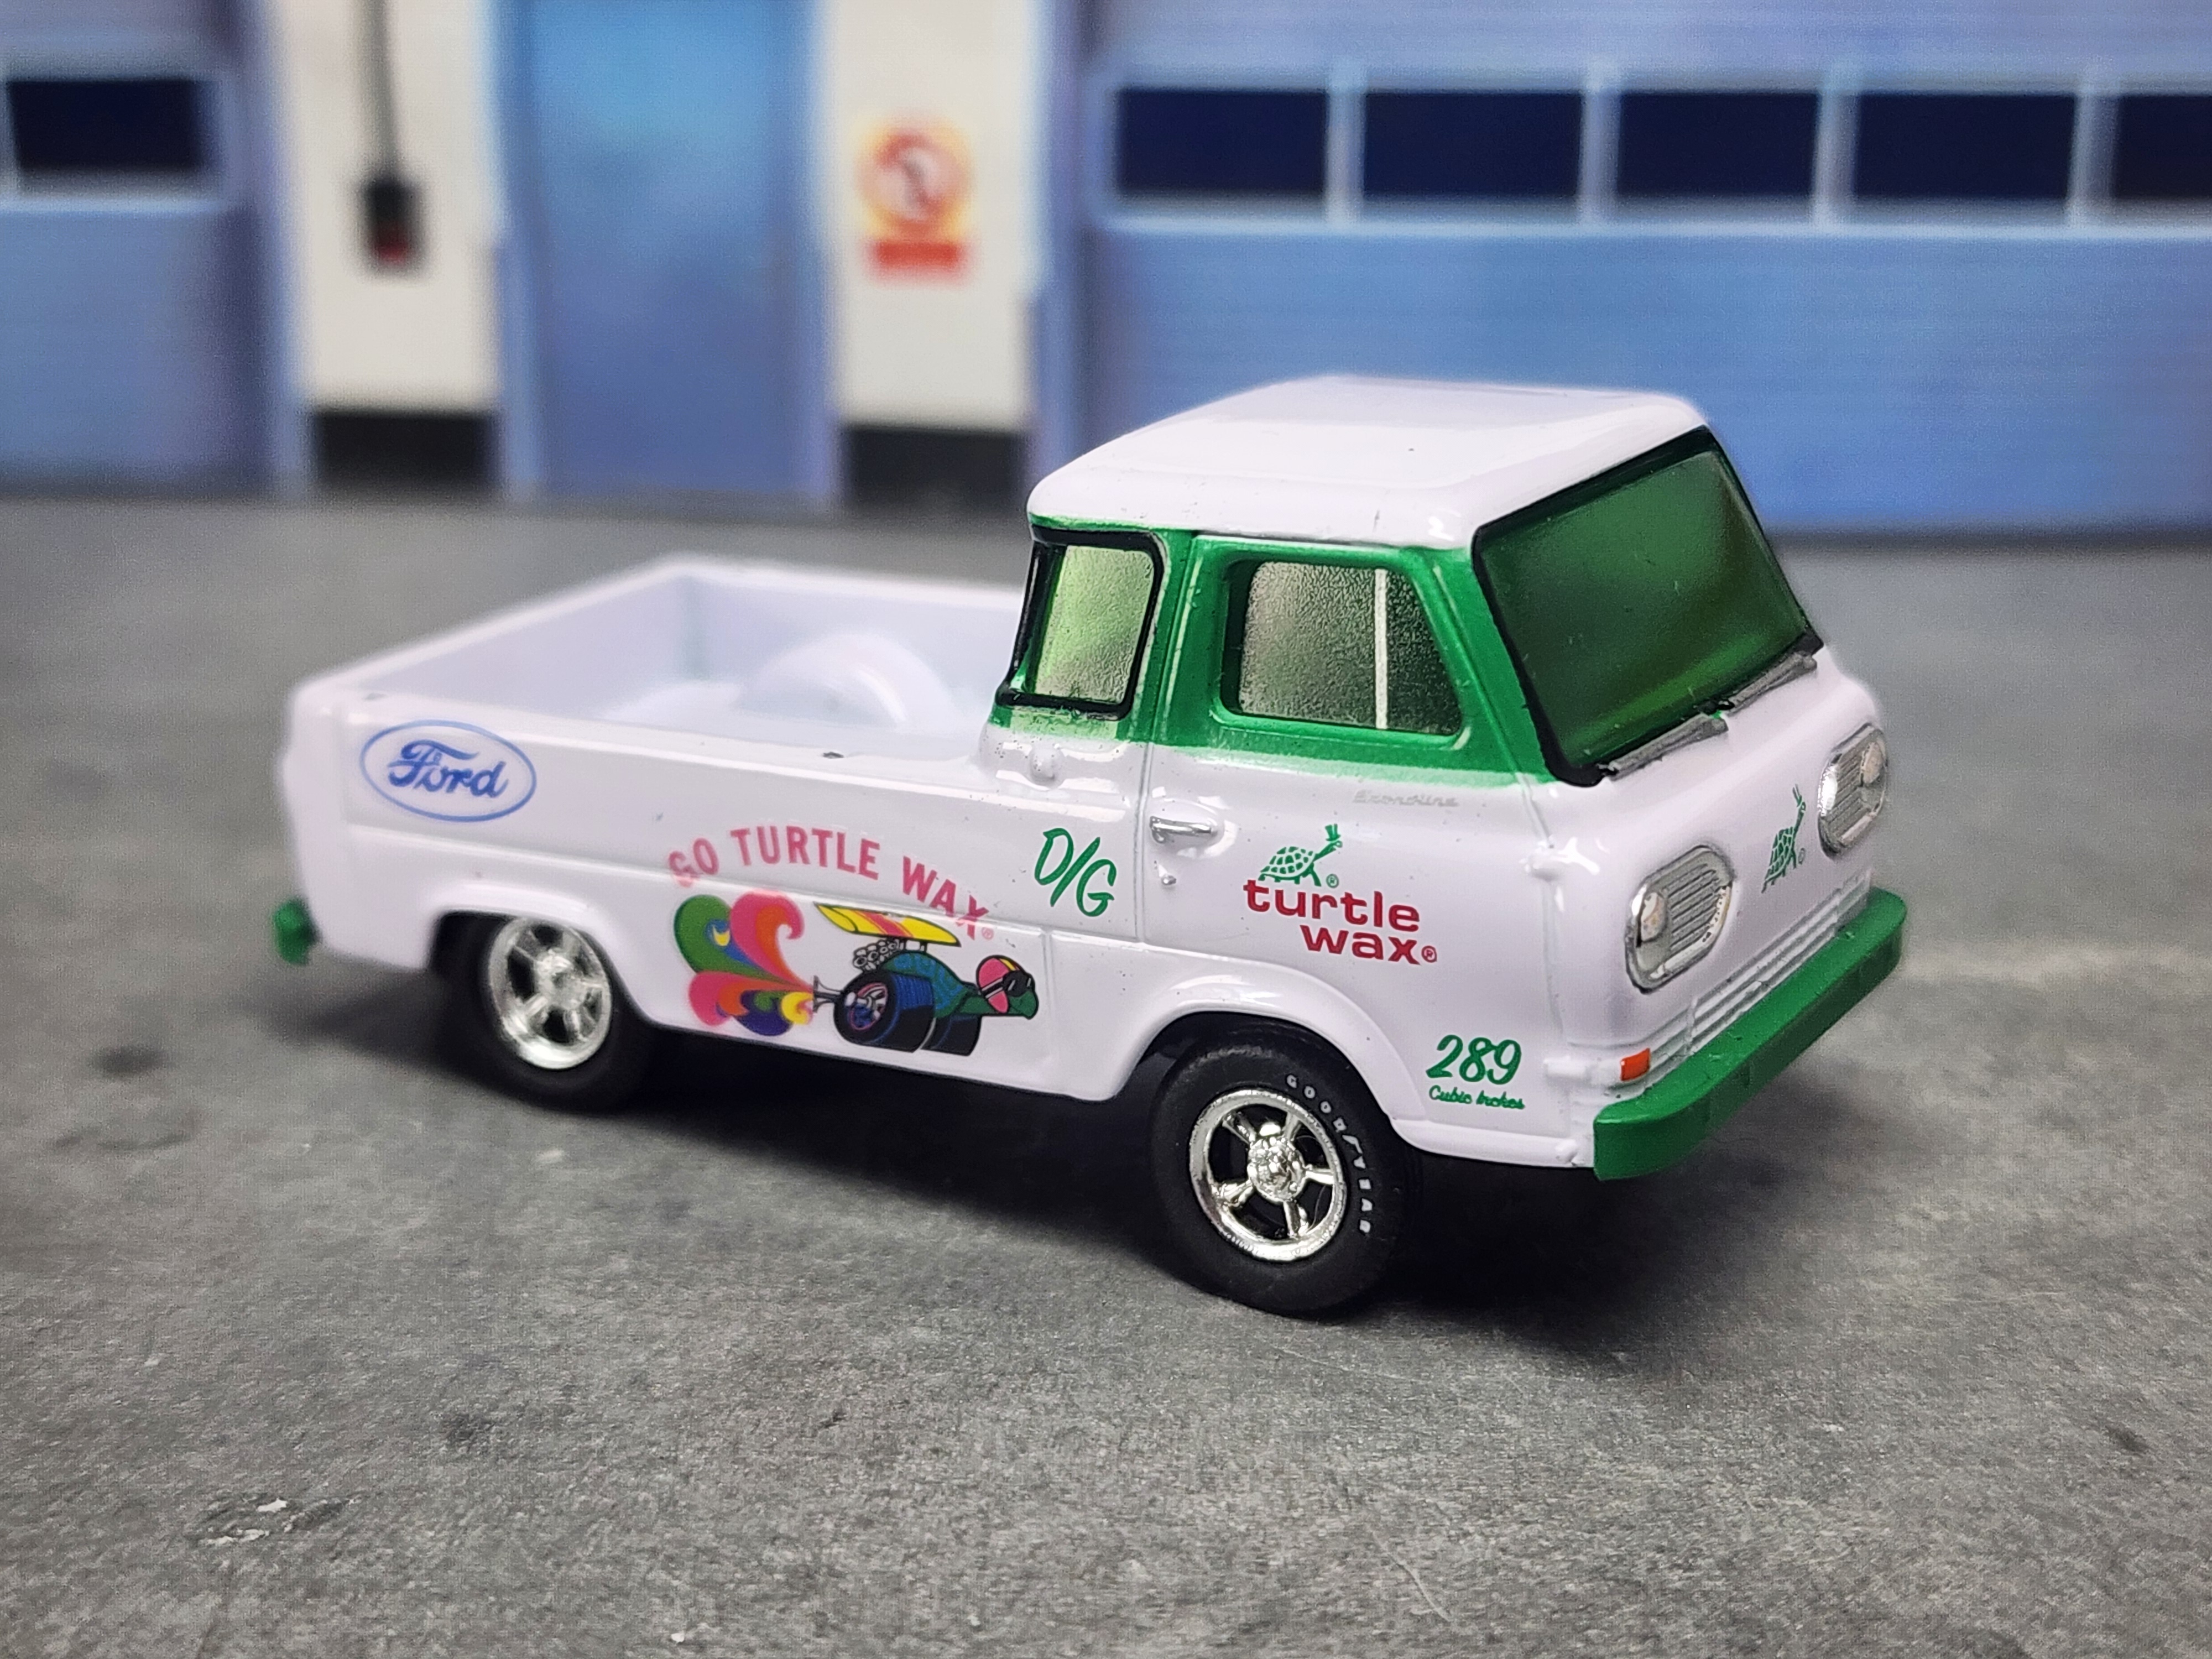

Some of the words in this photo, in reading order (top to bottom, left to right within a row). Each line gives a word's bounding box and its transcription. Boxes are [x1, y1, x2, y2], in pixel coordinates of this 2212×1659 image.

[388, 739, 509, 798] Ford
[668, 838, 718, 887] GO
[730, 826, 880, 880] TURTLE
[902, 855, 990, 941] WAX
[1035, 827, 1117, 917] D/G
[1243, 880, 1420, 932] turtle
[1300, 925, 1421, 965] wax
[1426, 1035, 1522, 1085] 289
[1429, 1085, 1473, 1104] Cubic
